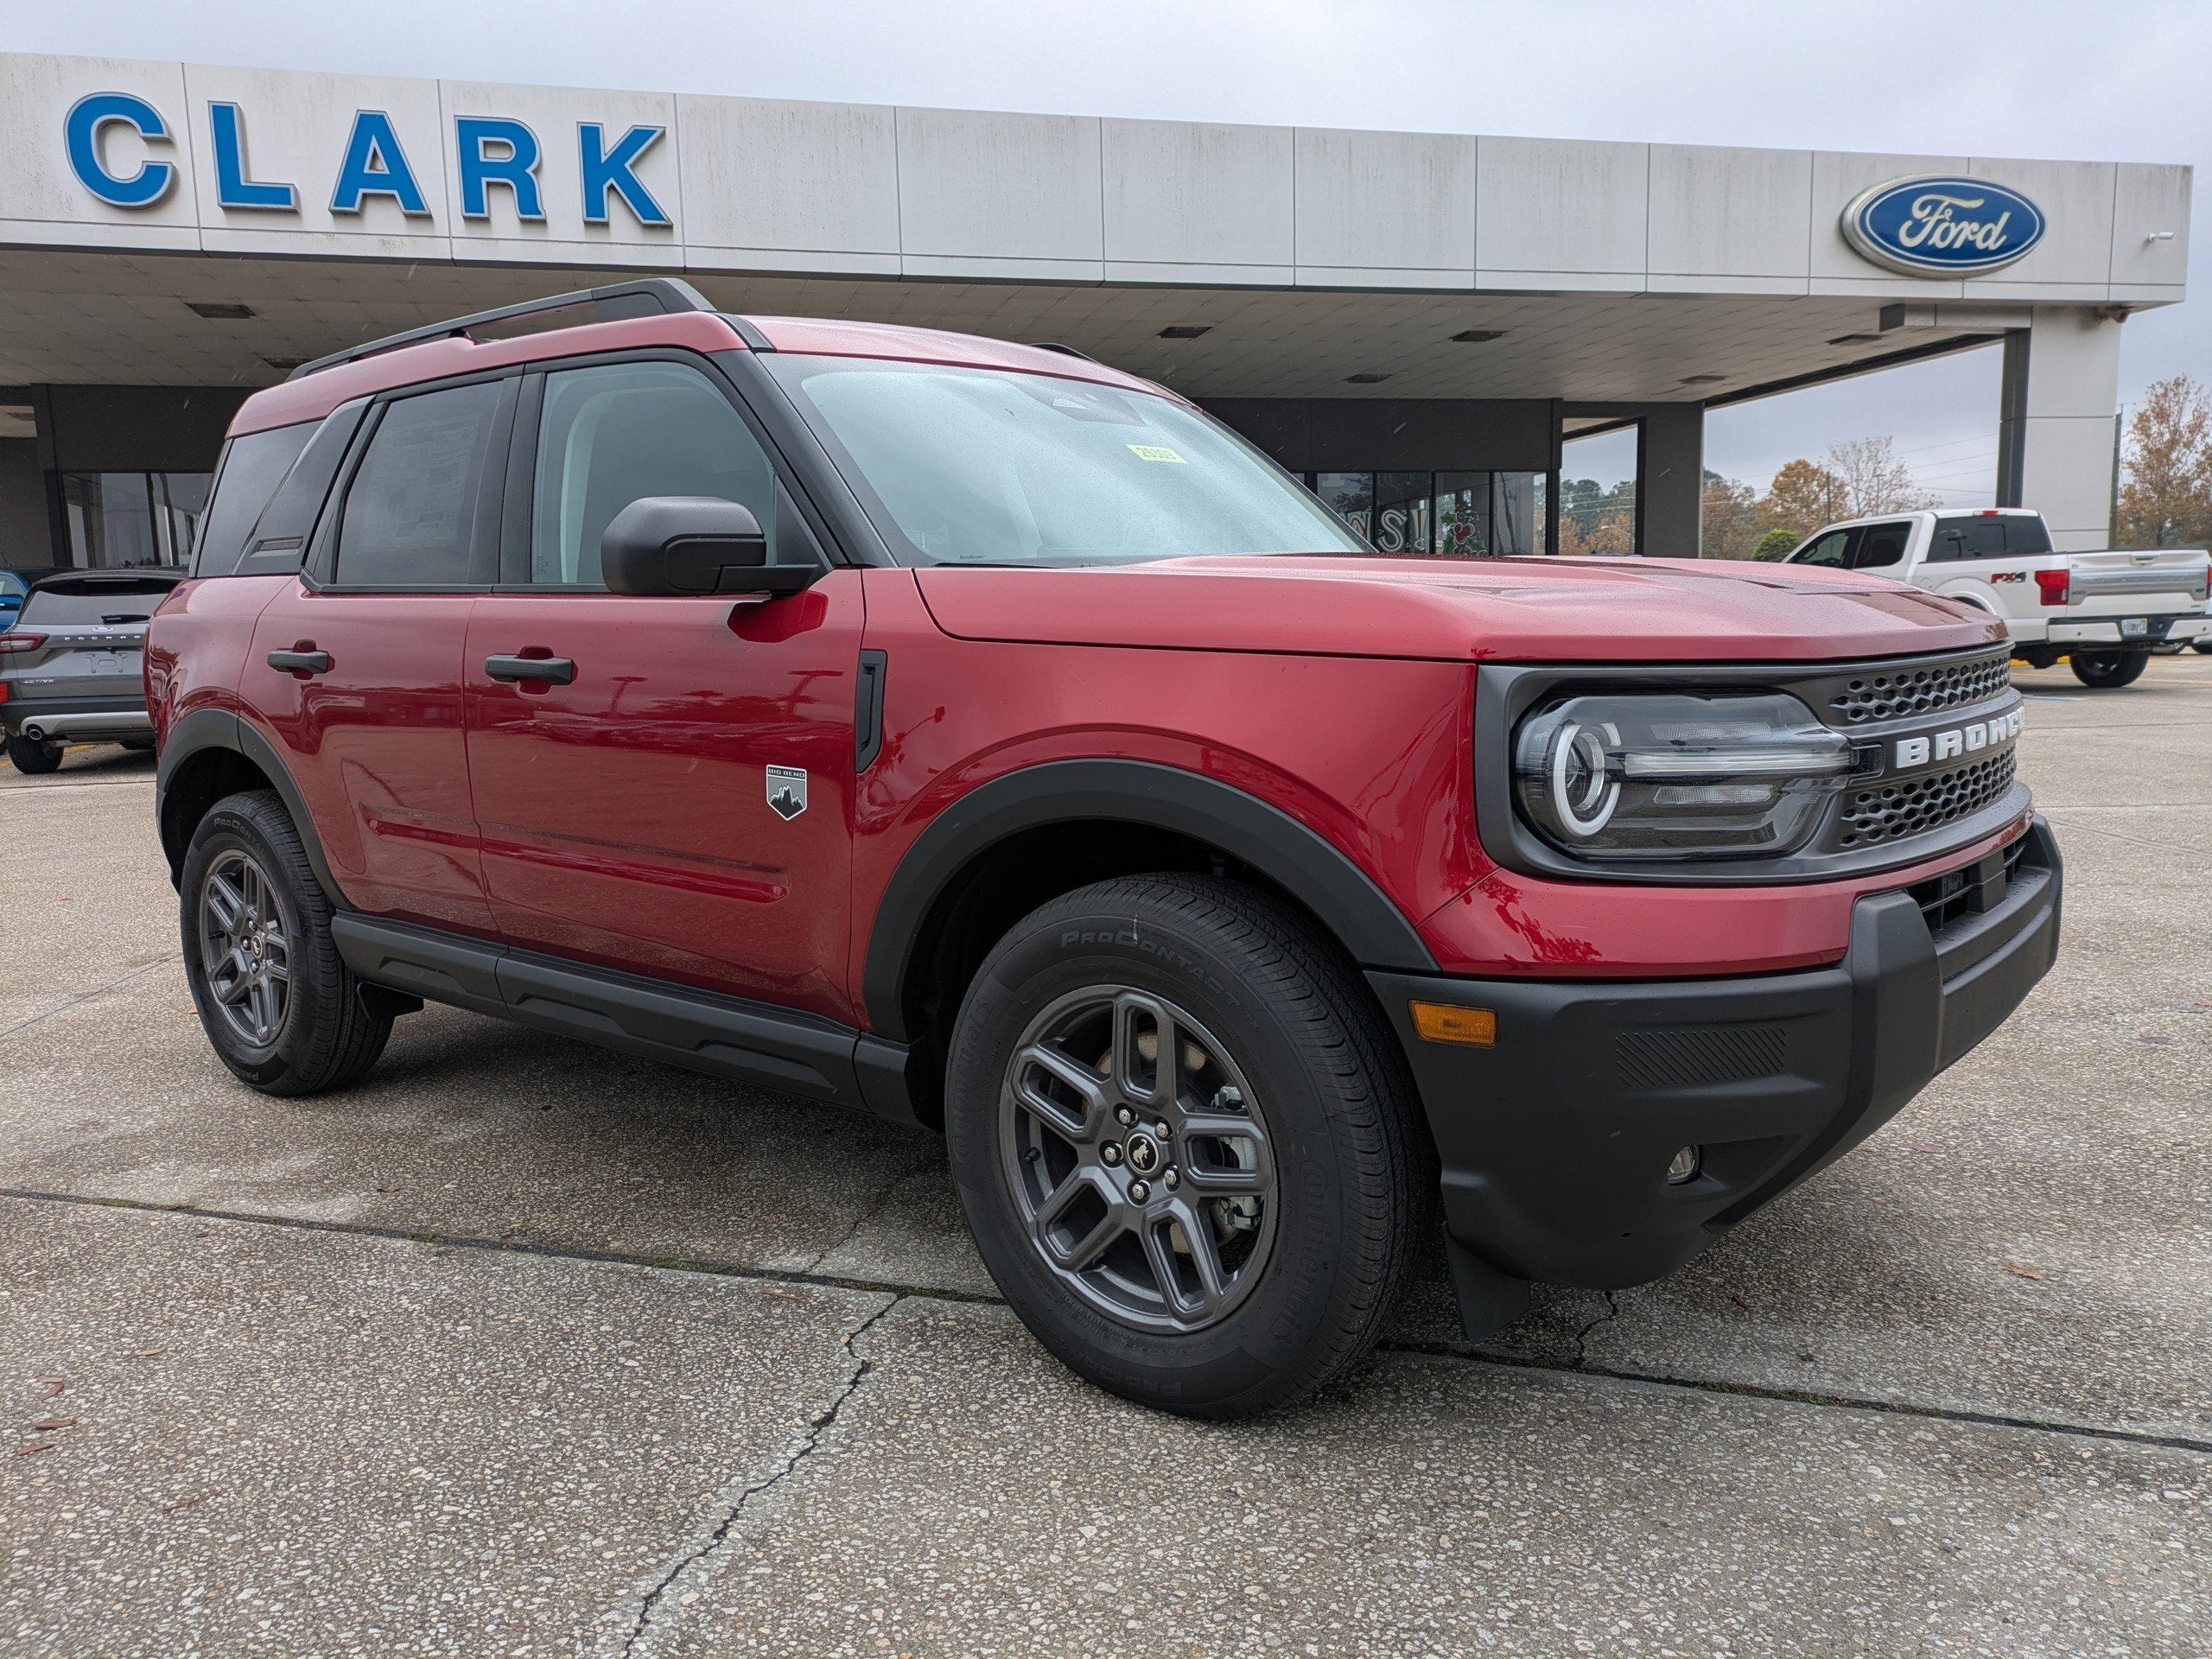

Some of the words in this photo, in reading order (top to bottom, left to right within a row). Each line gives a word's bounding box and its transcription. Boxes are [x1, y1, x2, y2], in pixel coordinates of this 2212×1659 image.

[64, 92, 673, 229] CLARK
[1898, 194, 2012, 251] Ford
[1991, 571, 2027, 584] FX4
